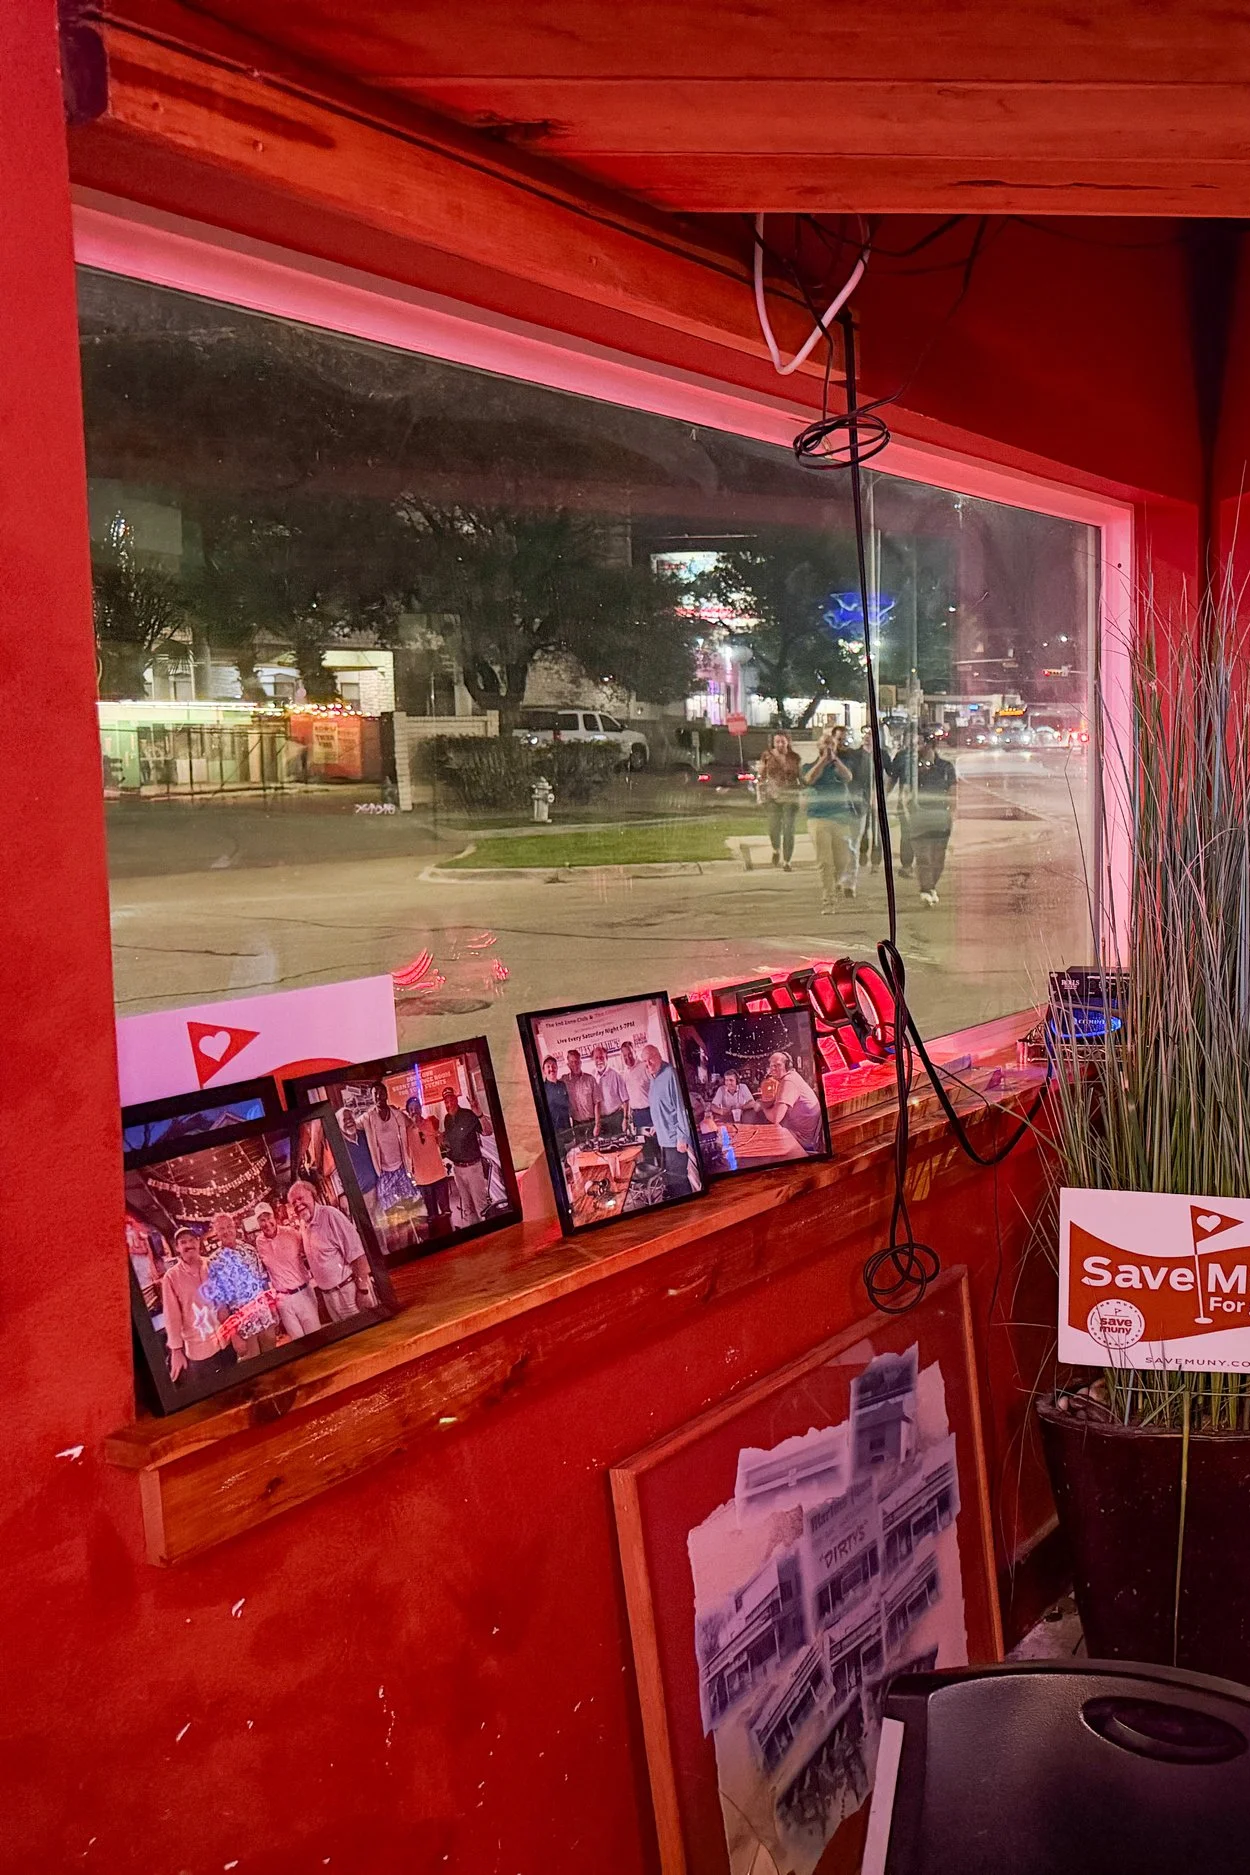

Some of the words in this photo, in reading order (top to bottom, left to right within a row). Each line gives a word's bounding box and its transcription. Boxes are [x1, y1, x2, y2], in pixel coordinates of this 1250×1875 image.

[567, 1035, 581, 1043] Every
[581, 1030, 604, 1041] Saturday
[604, 1025, 620, 1035] Night
[1081, 1255, 1195, 1292] Save
[1208, 1295, 1246, 1313] For
[1100, 1317, 1133, 1327] save
[1100, 1326, 1132, 1335] muny
